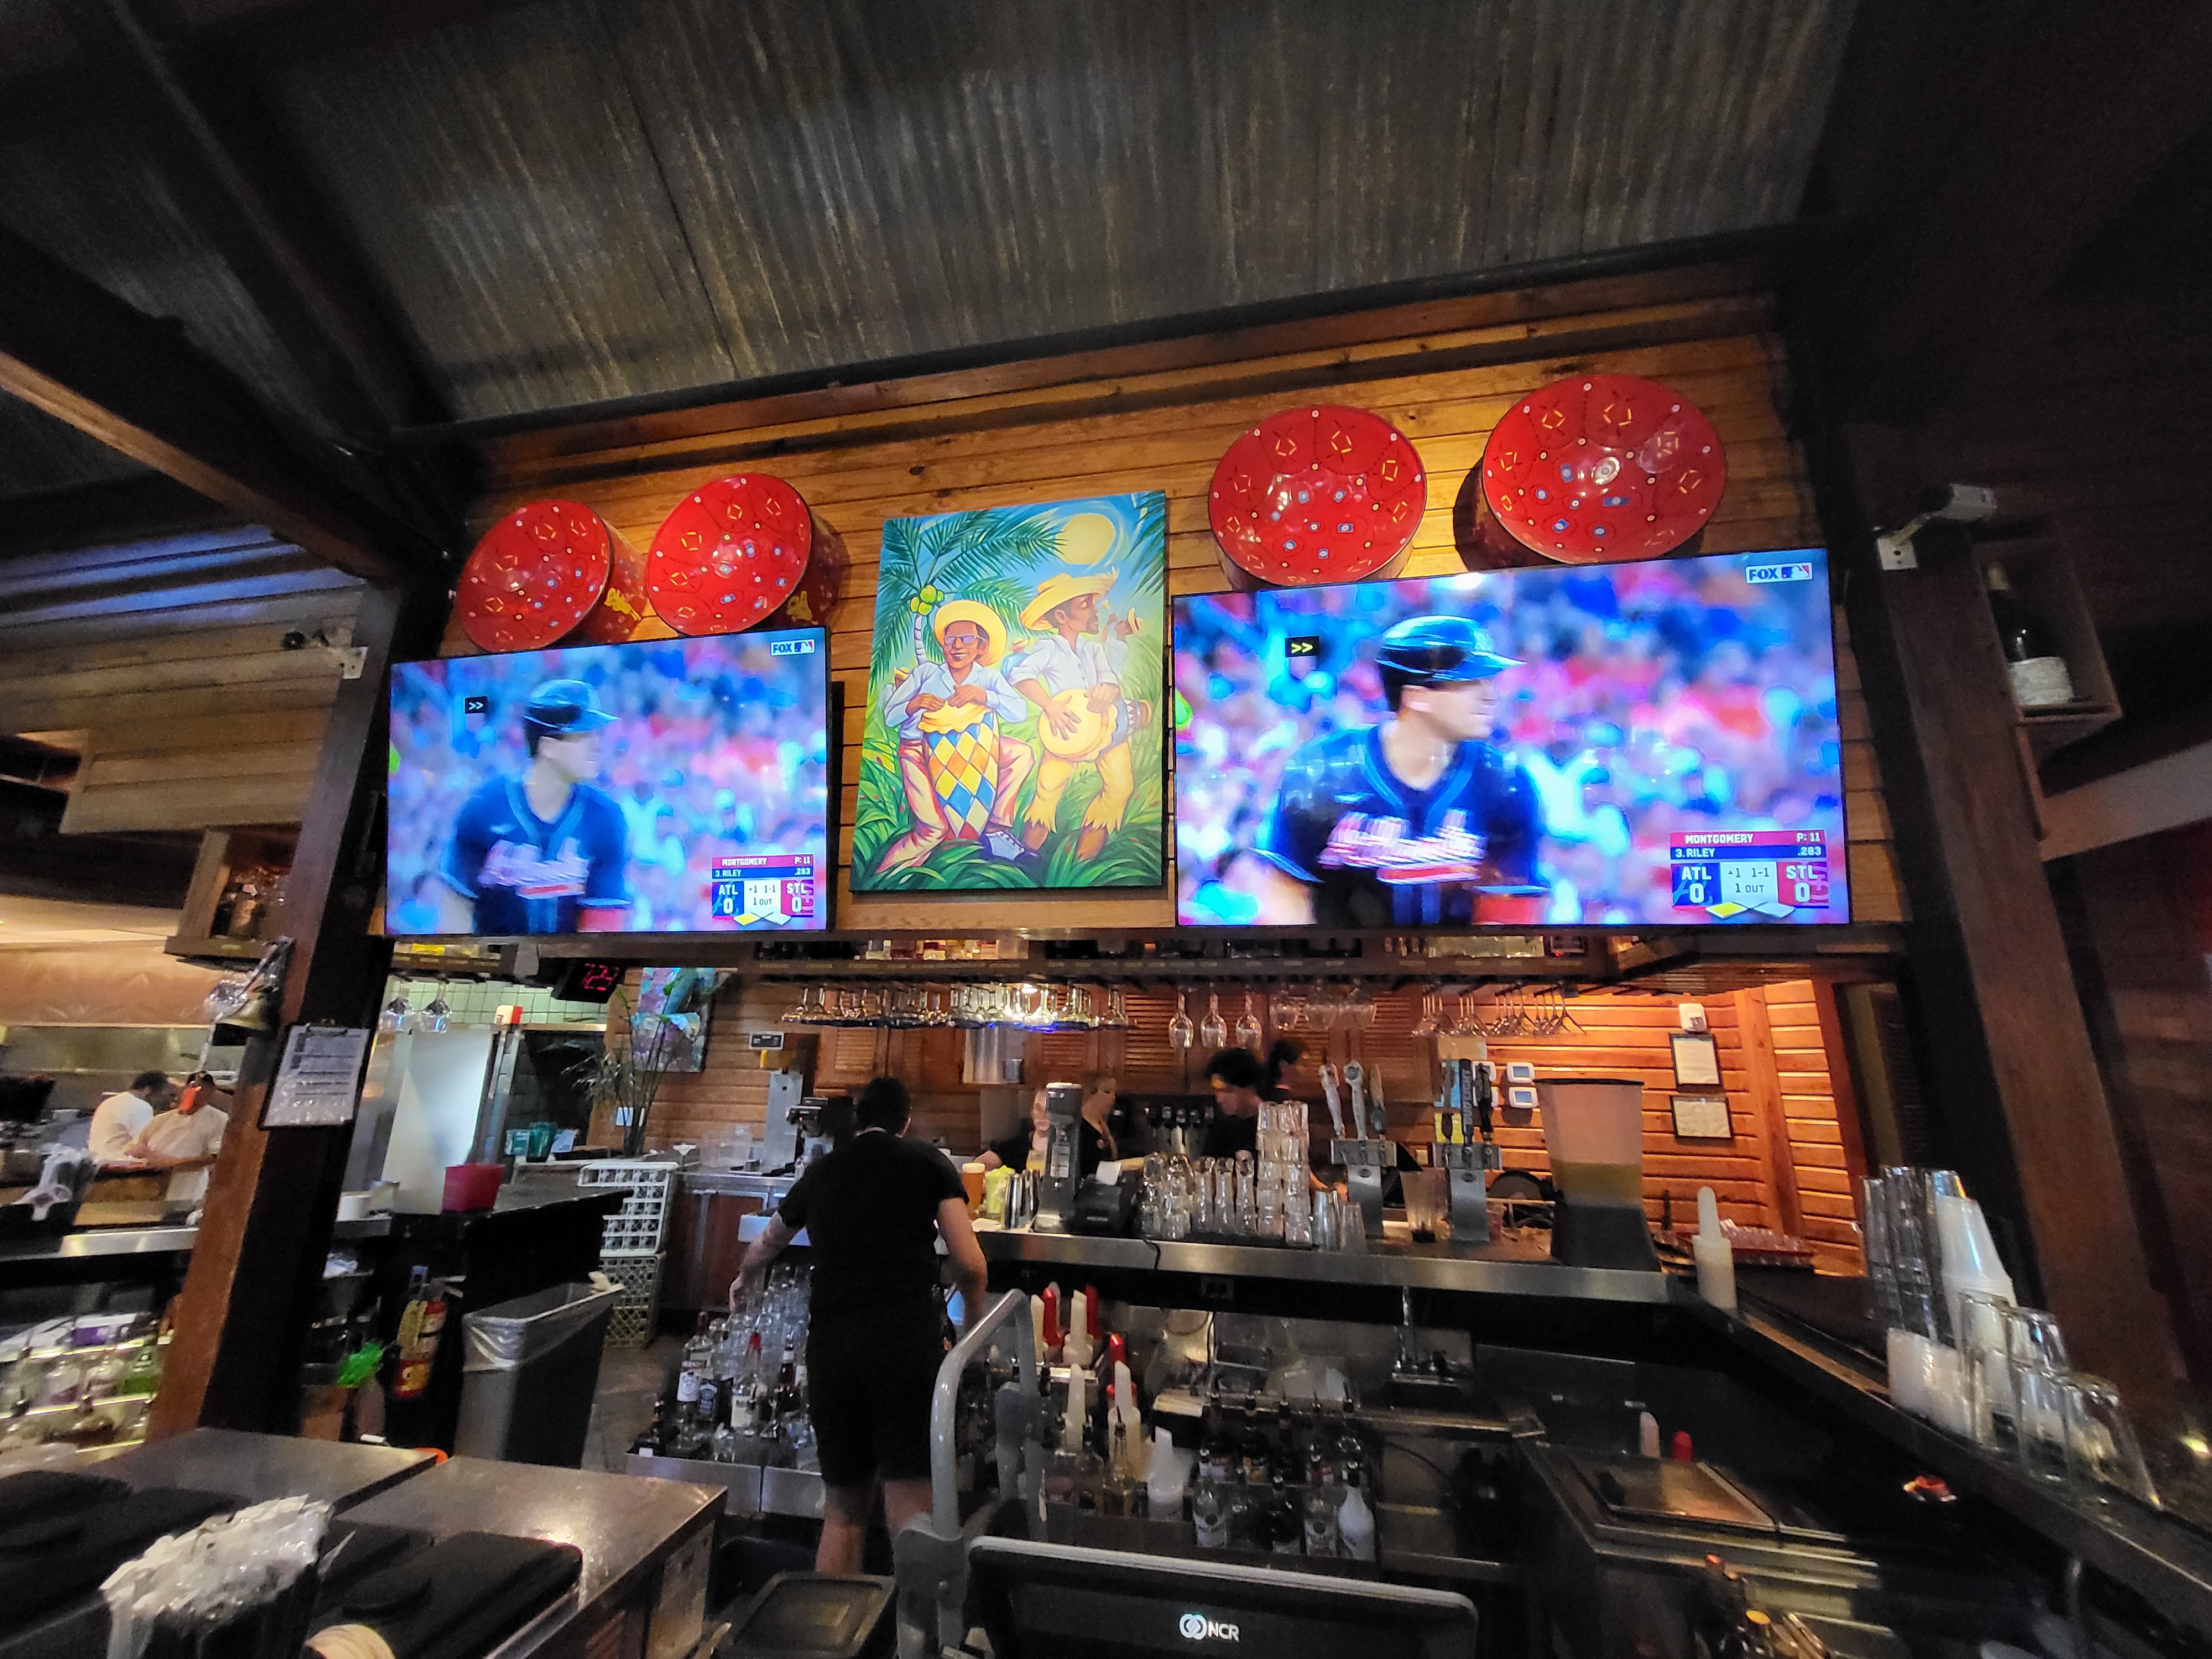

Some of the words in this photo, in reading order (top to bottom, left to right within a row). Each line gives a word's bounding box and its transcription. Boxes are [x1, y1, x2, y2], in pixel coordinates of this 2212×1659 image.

[1749, 567, 1778, 581] FOX
[773, 643, 792, 654] FOX
[1685, 833, 1754, 844] MONTGOMERY
[1809, 832, 1821, 842] 11
[1686, 848, 1715, 858] RILEY
[722, 857, 768, 867] MONTGOMERY
[803, 855, 811, 864] 11
[1682, 866, 1712, 880] ATL
[1751, 867, 1770, 878] 1-1
[1786, 865, 1818, 879] STL
[718, 884, 739, 895] ATL
[786, 883, 807, 895] STL
[1689, 883, 1705, 904] 0
[1735, 883, 1741, 893] 1
[1745, 884, 1765, 894] OUT
[1794, 881, 1811, 903] 0
[723, 898, 734, 914] 0
[791, 896, 802, 912] 0
[1208, 1621, 1240, 1642] NCR
